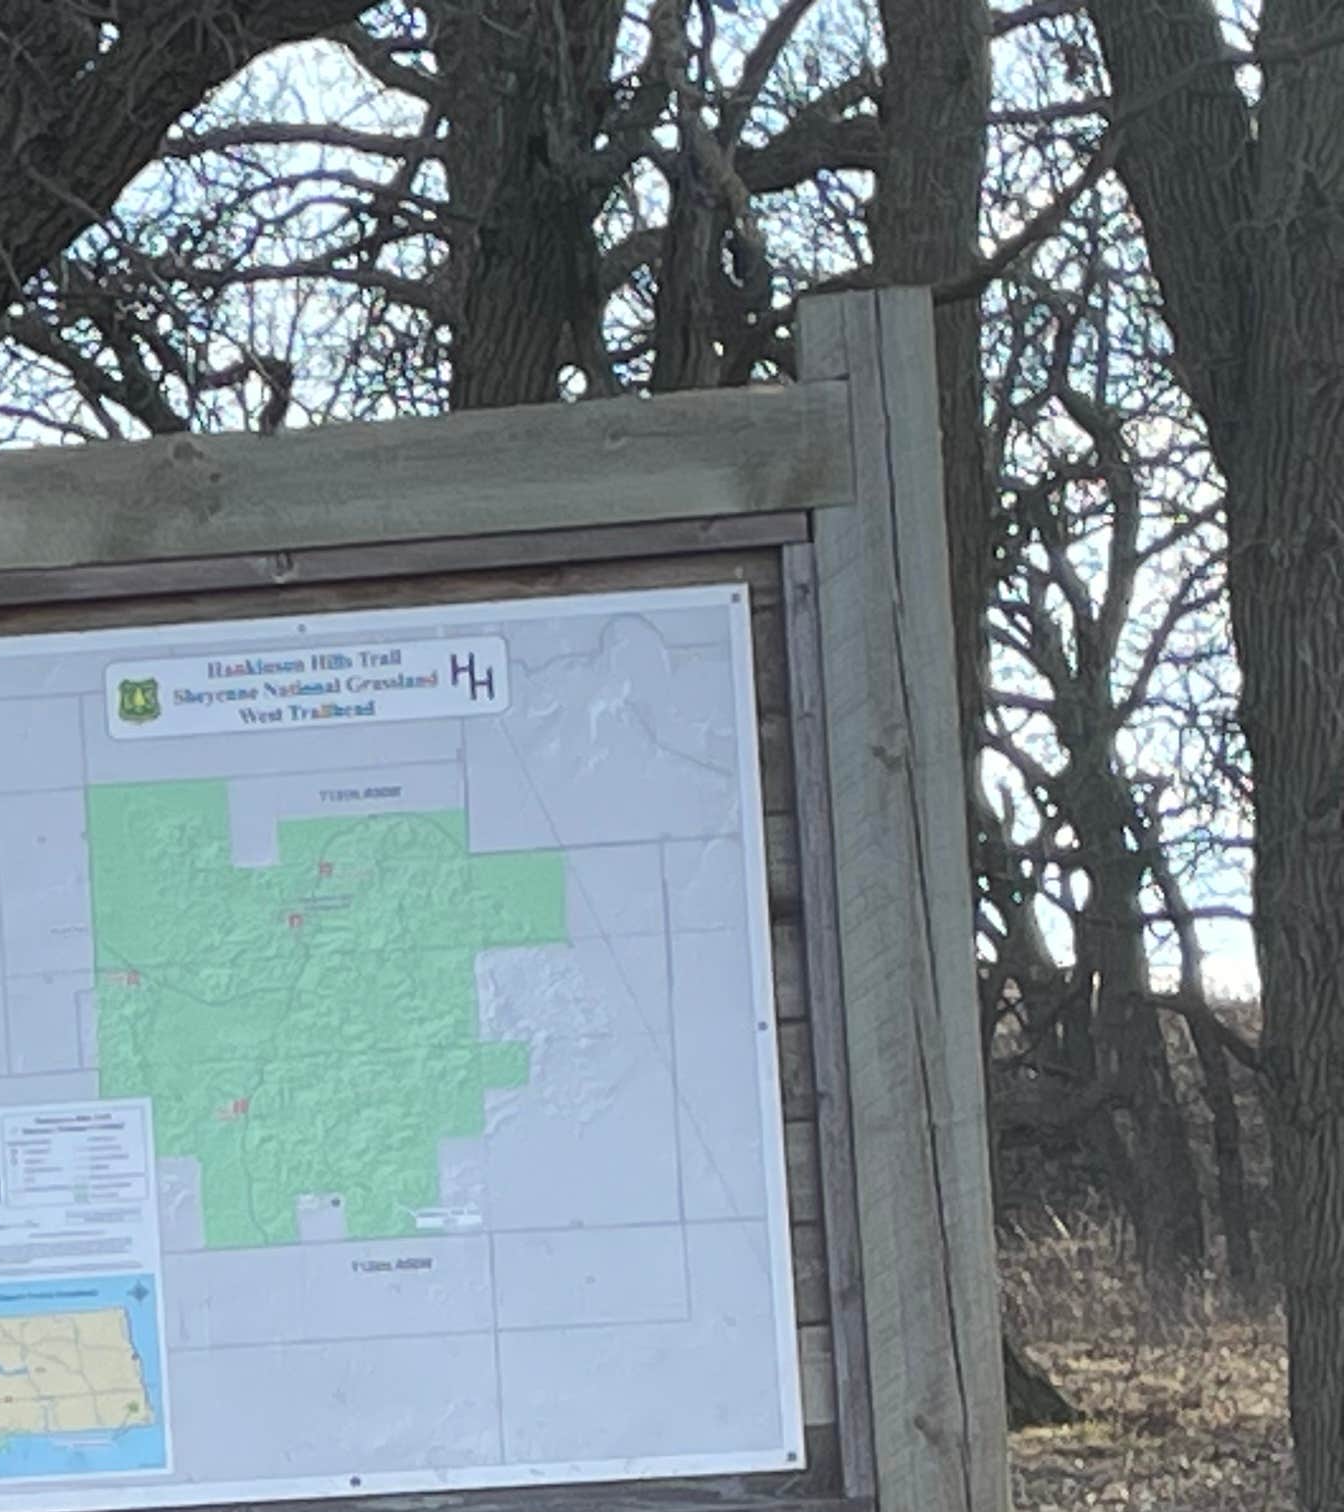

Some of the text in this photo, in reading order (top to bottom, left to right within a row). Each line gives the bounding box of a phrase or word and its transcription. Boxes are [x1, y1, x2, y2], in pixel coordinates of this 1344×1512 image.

[360, 649, 402, 668] Trail
[346, 671, 438, 693] Grassland
[239, 706, 283, 726] West
